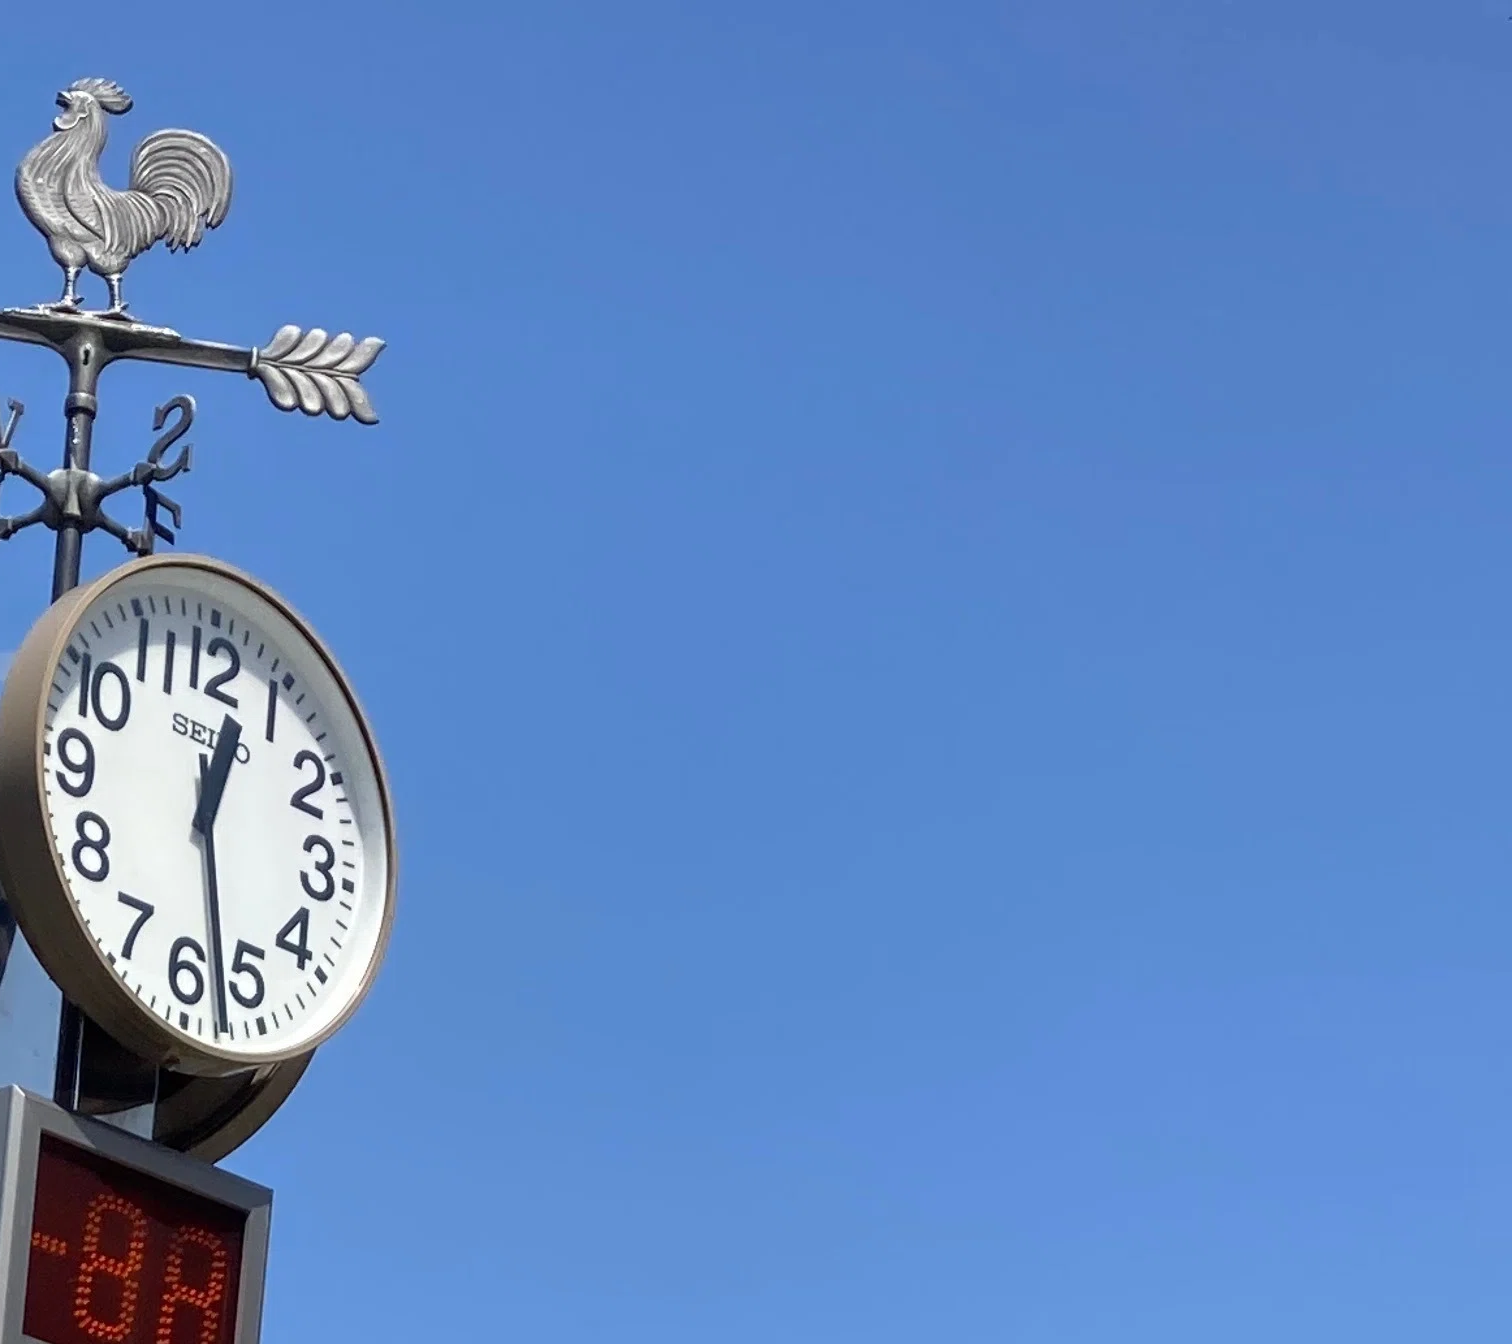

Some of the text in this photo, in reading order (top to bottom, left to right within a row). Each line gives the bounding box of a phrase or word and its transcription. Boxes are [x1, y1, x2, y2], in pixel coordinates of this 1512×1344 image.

[137, 618, 175, 694] 11
[189, 625, 241, 708] 12
[79, 652, 130, 731] 10
[265, 679, 278, 742] 1
[55, 728, 95, 798] 9
[172, 712, 251, 765] SEIO
[290, 750, 326, 820] 2
[71, 811, 111, 882] 8
[300, 835, 335, 902] 3
[117, 891, 154, 960] 7
[275, 906, 312, 970] 4
[168, 936, 206, 1005] 6
[228, 939, 265, 1009] 5
